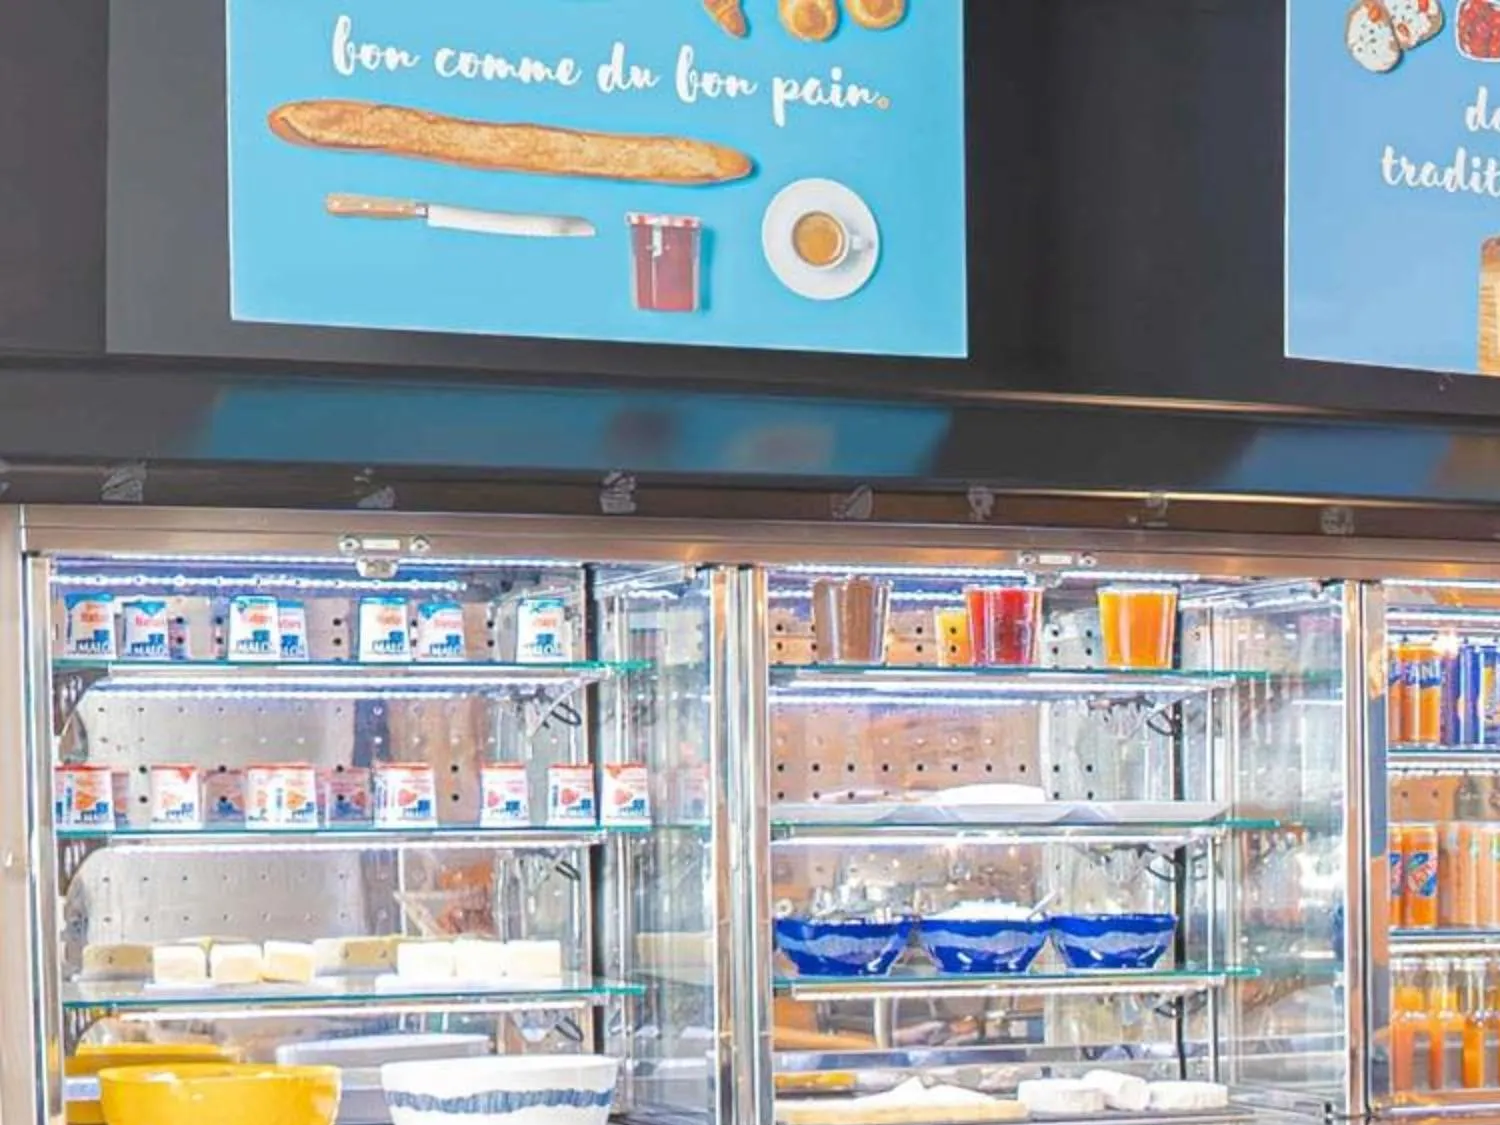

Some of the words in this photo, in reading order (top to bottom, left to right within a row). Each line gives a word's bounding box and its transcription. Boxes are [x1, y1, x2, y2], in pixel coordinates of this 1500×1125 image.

[332, 15, 420, 75] bon
[435, 47, 582, 86] comme
[598, 43, 660, 93] du
[676, 45, 759, 103] bon
